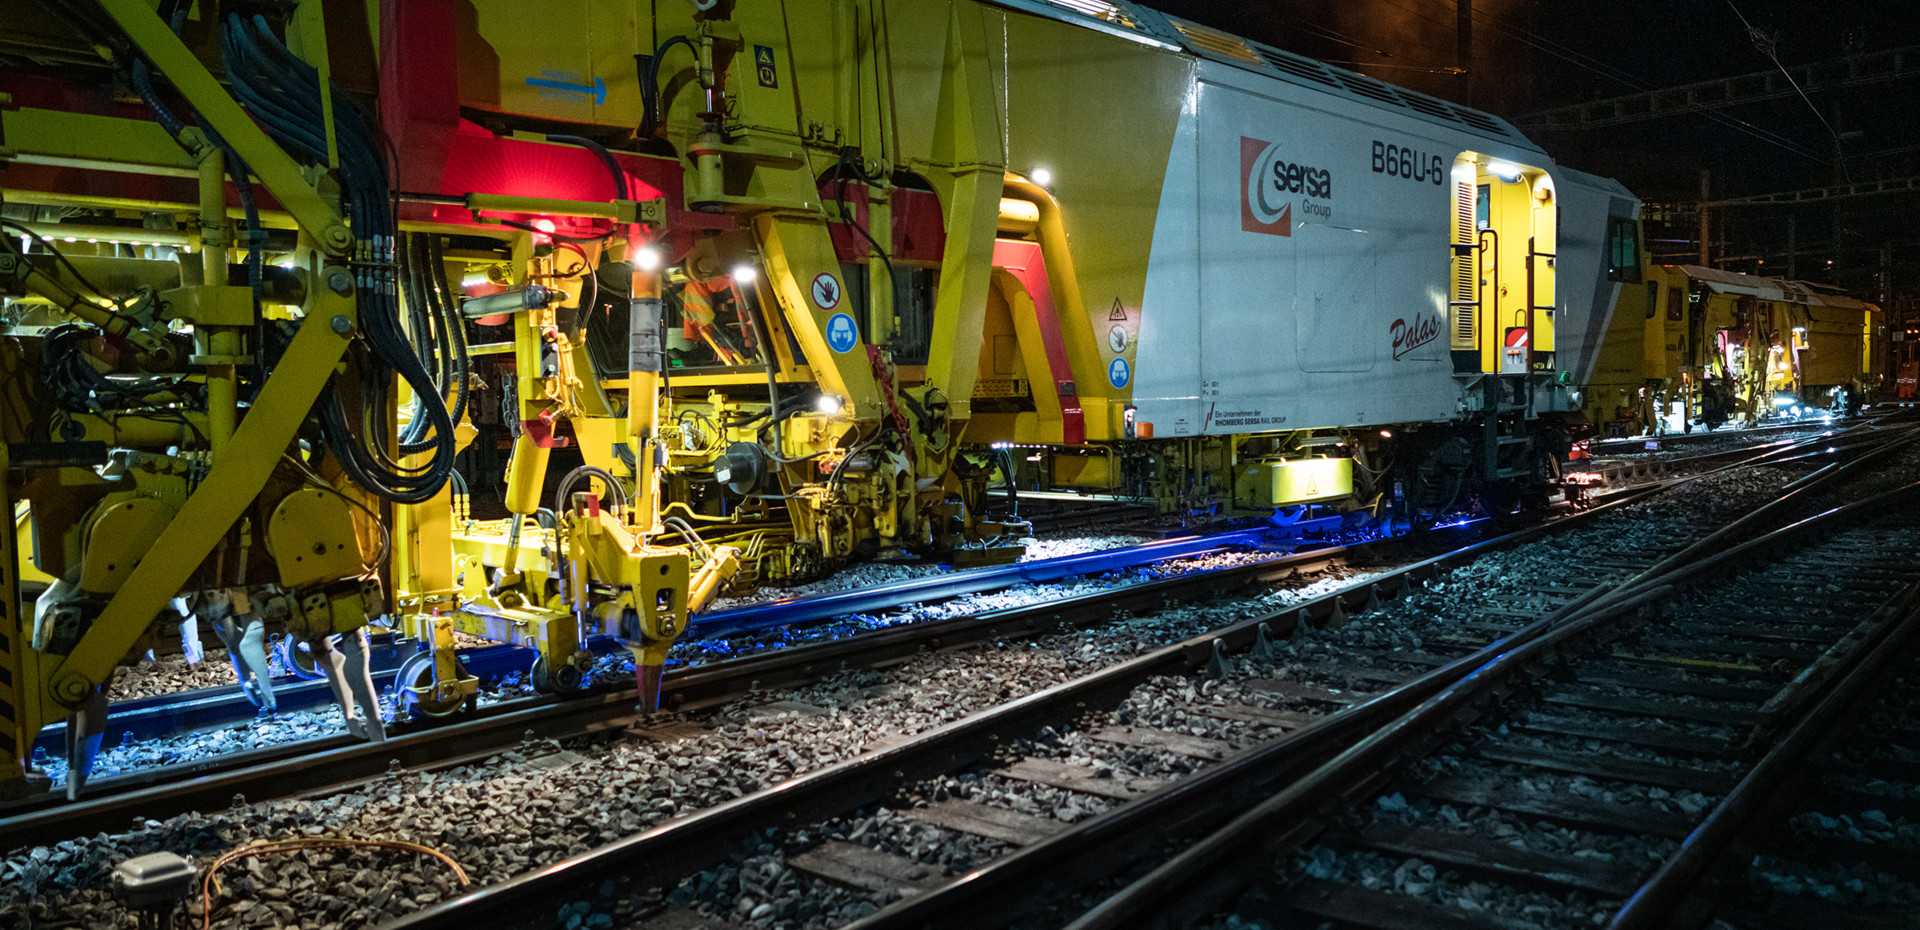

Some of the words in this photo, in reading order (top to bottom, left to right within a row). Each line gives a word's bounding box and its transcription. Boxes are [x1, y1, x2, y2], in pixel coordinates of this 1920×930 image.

[1273, 160, 1331, 199] sersa
[1372, 140, 1443, 186] B66U-6
[1302, 199, 1331, 220] Group
[1390, 312, 1441, 361] Palas
[1215, 418, 1243, 426] RHOMBERG
